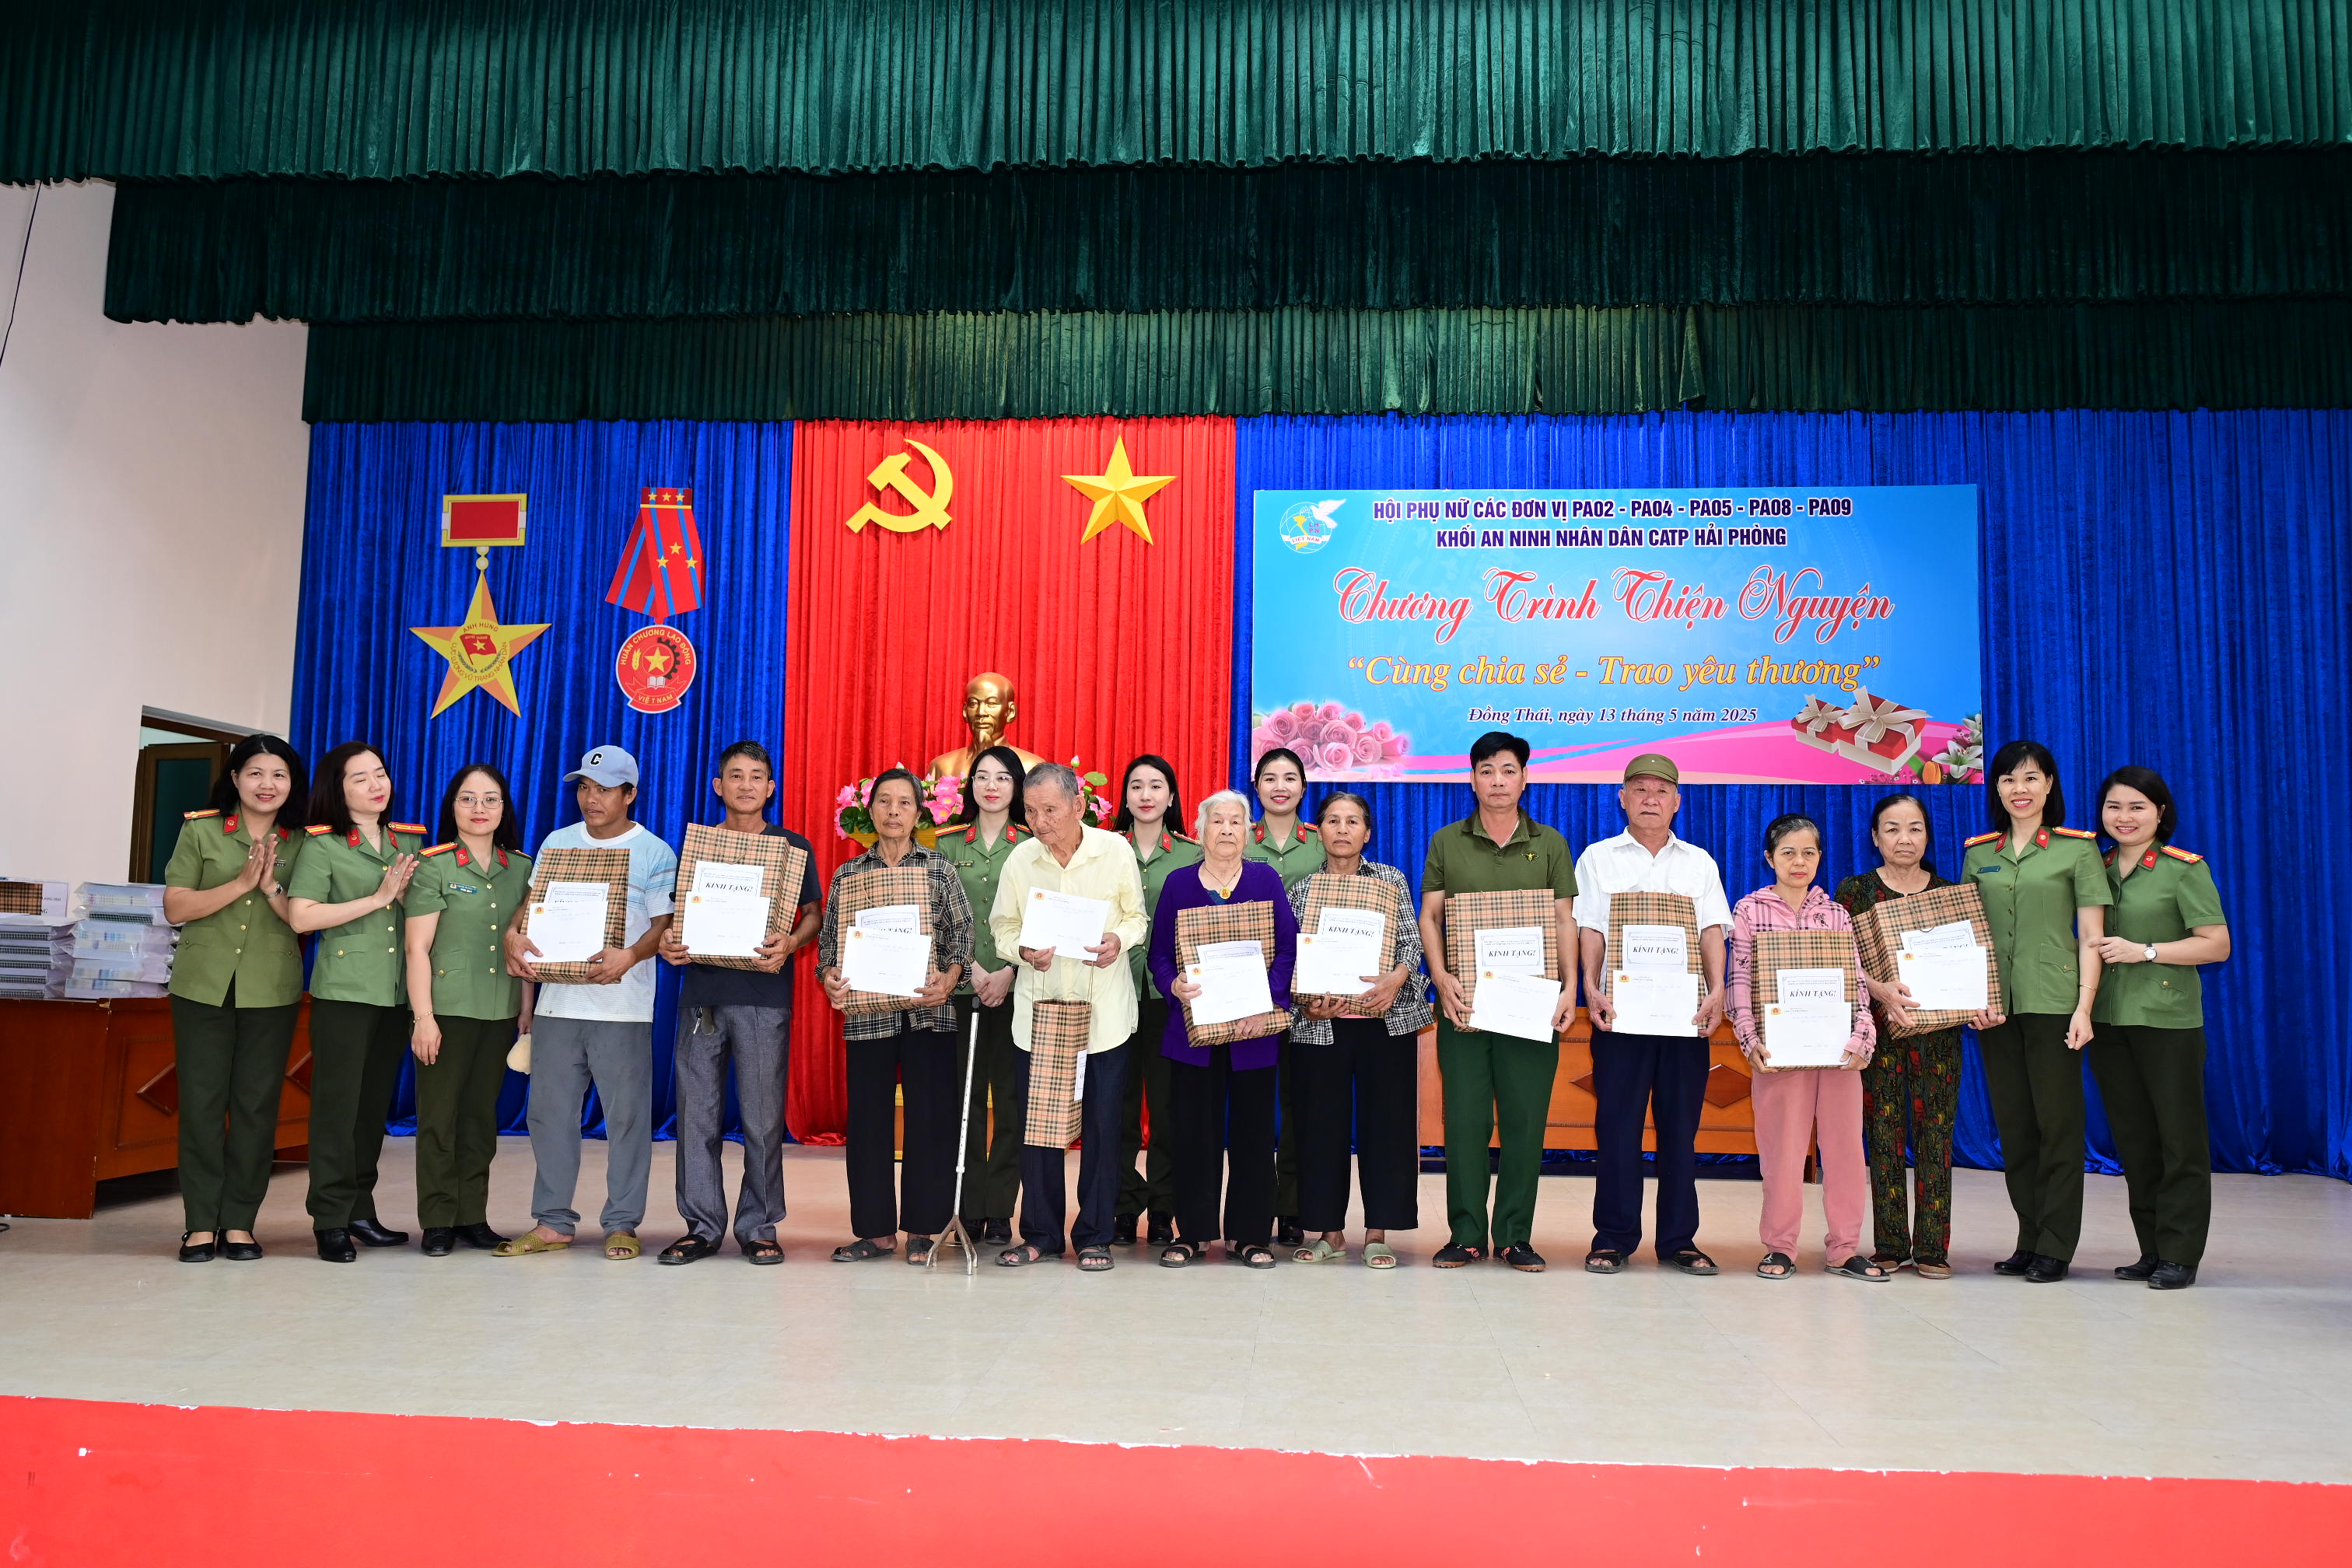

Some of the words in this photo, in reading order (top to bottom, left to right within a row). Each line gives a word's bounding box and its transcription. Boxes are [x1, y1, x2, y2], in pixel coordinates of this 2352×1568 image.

[1374, 499, 1401, 523] HỘI
[1407, 502, 1440, 523] PHỤ
[1445, 499, 1470, 519] NỮ
[1473, 498, 1506, 518] CÁC
[1511, 499, 1547, 518] ĐƠN
[1552, 501, 1566, 522] VỊ
[1573, 501, 1614, 517] PA02
[1631, 500, 1673, 517] PA04
[1690, 499, 1732, 516] PA05
[1749, 499, 1791, 516] PA08
[1808, 499, 1851, 516] PA09
[1437, 524, 1475, 548] KHỐI
[1480, 530, 1503, 547] AN
[1510, 530, 1550, 547] NINH
[1556, 526, 1603, 547] NHÂN
[1608, 526, 1643, 546] DÂN
[1648, 529, 1689, 546] CATP
[1695, 523, 1723, 546] HẢI
[1728, 524, 1787, 545] PHÒNG
[1334, 567, 1472, 644] Chương
[1483, 568, 1601, 622] Trình
[1612, 567, 1727, 630] Thiện
[1738, 565, 1894, 643] Nguyện
[463, 623, 477, 633] ANH
[620, 642, 634, 665] HUÂN
[632, 628, 666, 644] CHƯƠNG
[667, 631, 681, 644] LAO
[679, 642, 691, 665] ĐỘNG
[1349, 656, 1451, 692] “Cùng
[1458, 655, 1525, 685] chia
[1534, 654, 1569, 685] sẻ
[1598, 656, 1673, 685] Trao
[1678, 655, 1737, 691] yêu
[1747, 655, 1881, 692] thương”
[656, 694, 674, 704] NAM
[1468, 706, 1510, 723] Đồng
[1515, 707, 1553, 723] Thái,
[1559, 709, 1594, 724] ngày
[1599, 708, 1615, 722] 13
[1621, 708, 1664, 724] tháng
[1668, 709, 1677, 722] 5
[1682, 709, 1716, 722] năm
[1720, 709, 1757, 722] 2025
[590, 751, 603, 766] C
